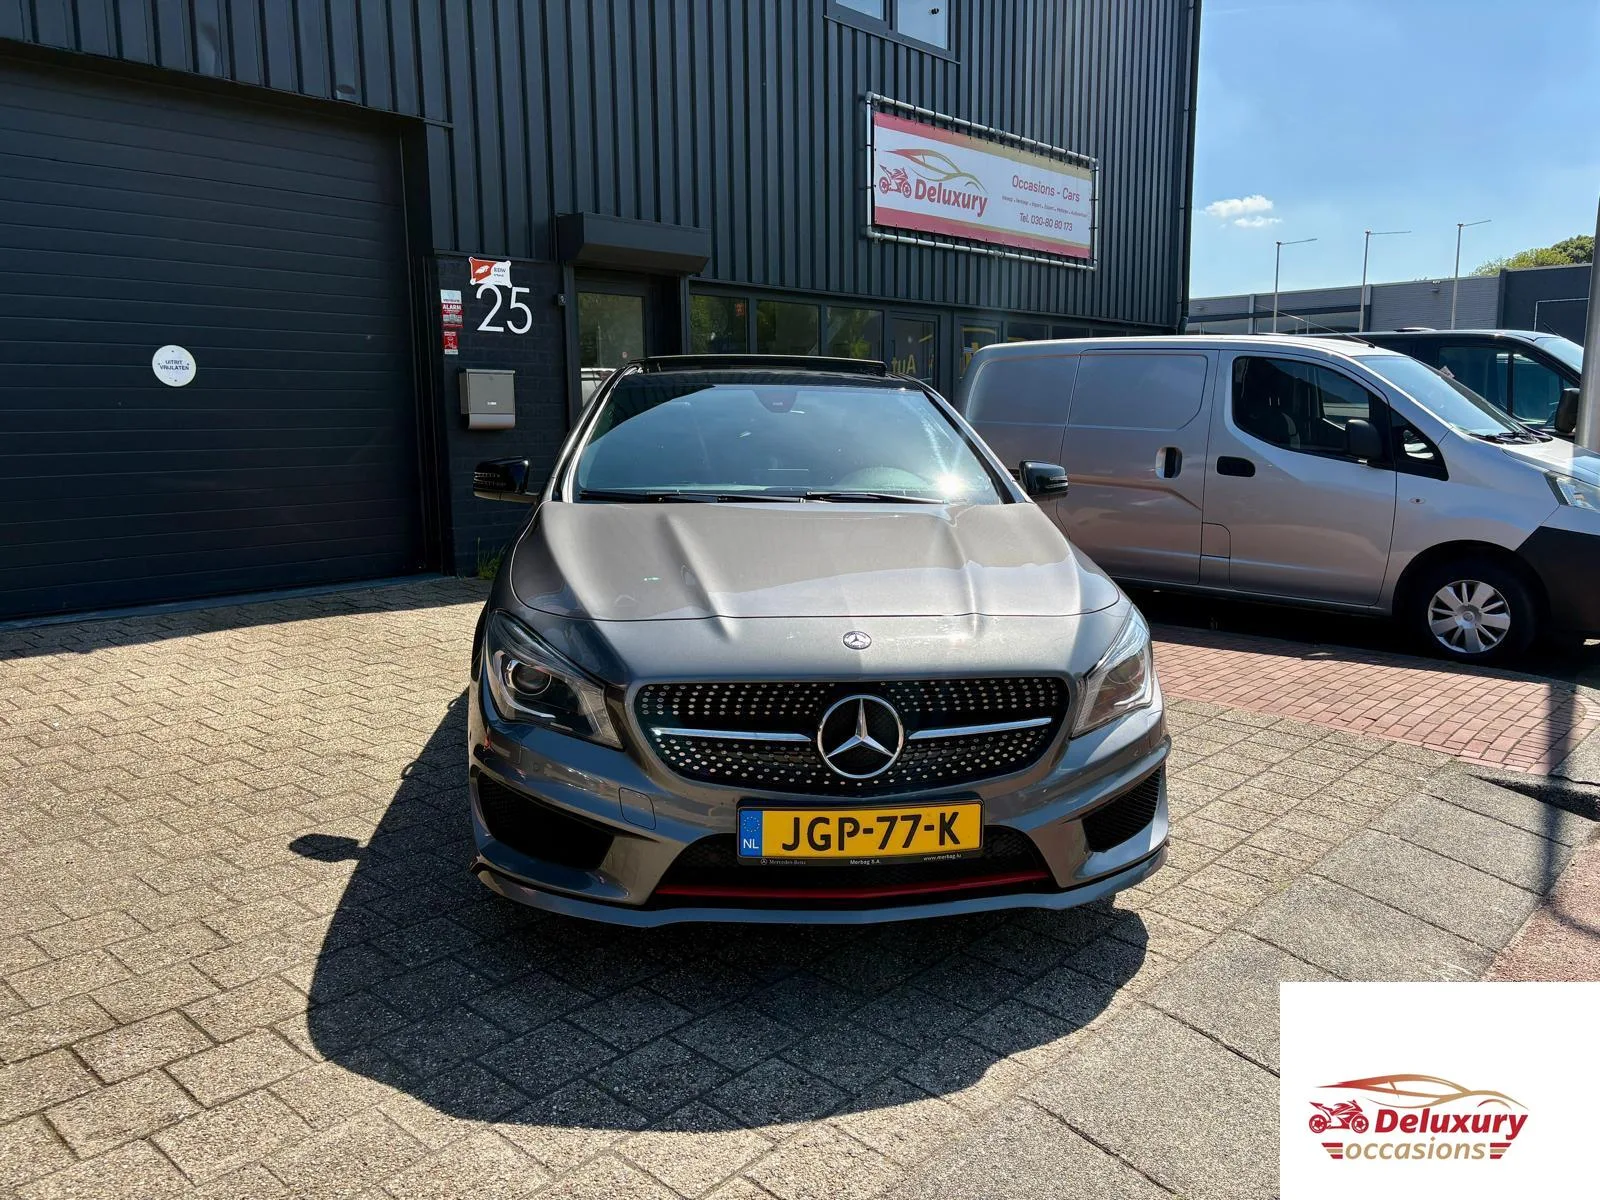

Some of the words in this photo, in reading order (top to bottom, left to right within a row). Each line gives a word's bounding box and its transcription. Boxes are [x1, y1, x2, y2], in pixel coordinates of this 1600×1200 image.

[914, 178, 988, 217] Deluxury
[1012, 174, 1055, 197] Occasions
[1062, 187, 1081, 202] Cars
[1030, 214, 1054, 229] 030-80
[1054, 219, 1063, 230] 80
[1063, 221, 1073, 232] 173
[442, 303, 462, 311] ALARM
[476, 283, 533, 335] 25
[742, 838, 760, 850] NL
[781, 811, 961, 852] JGP-77-K
